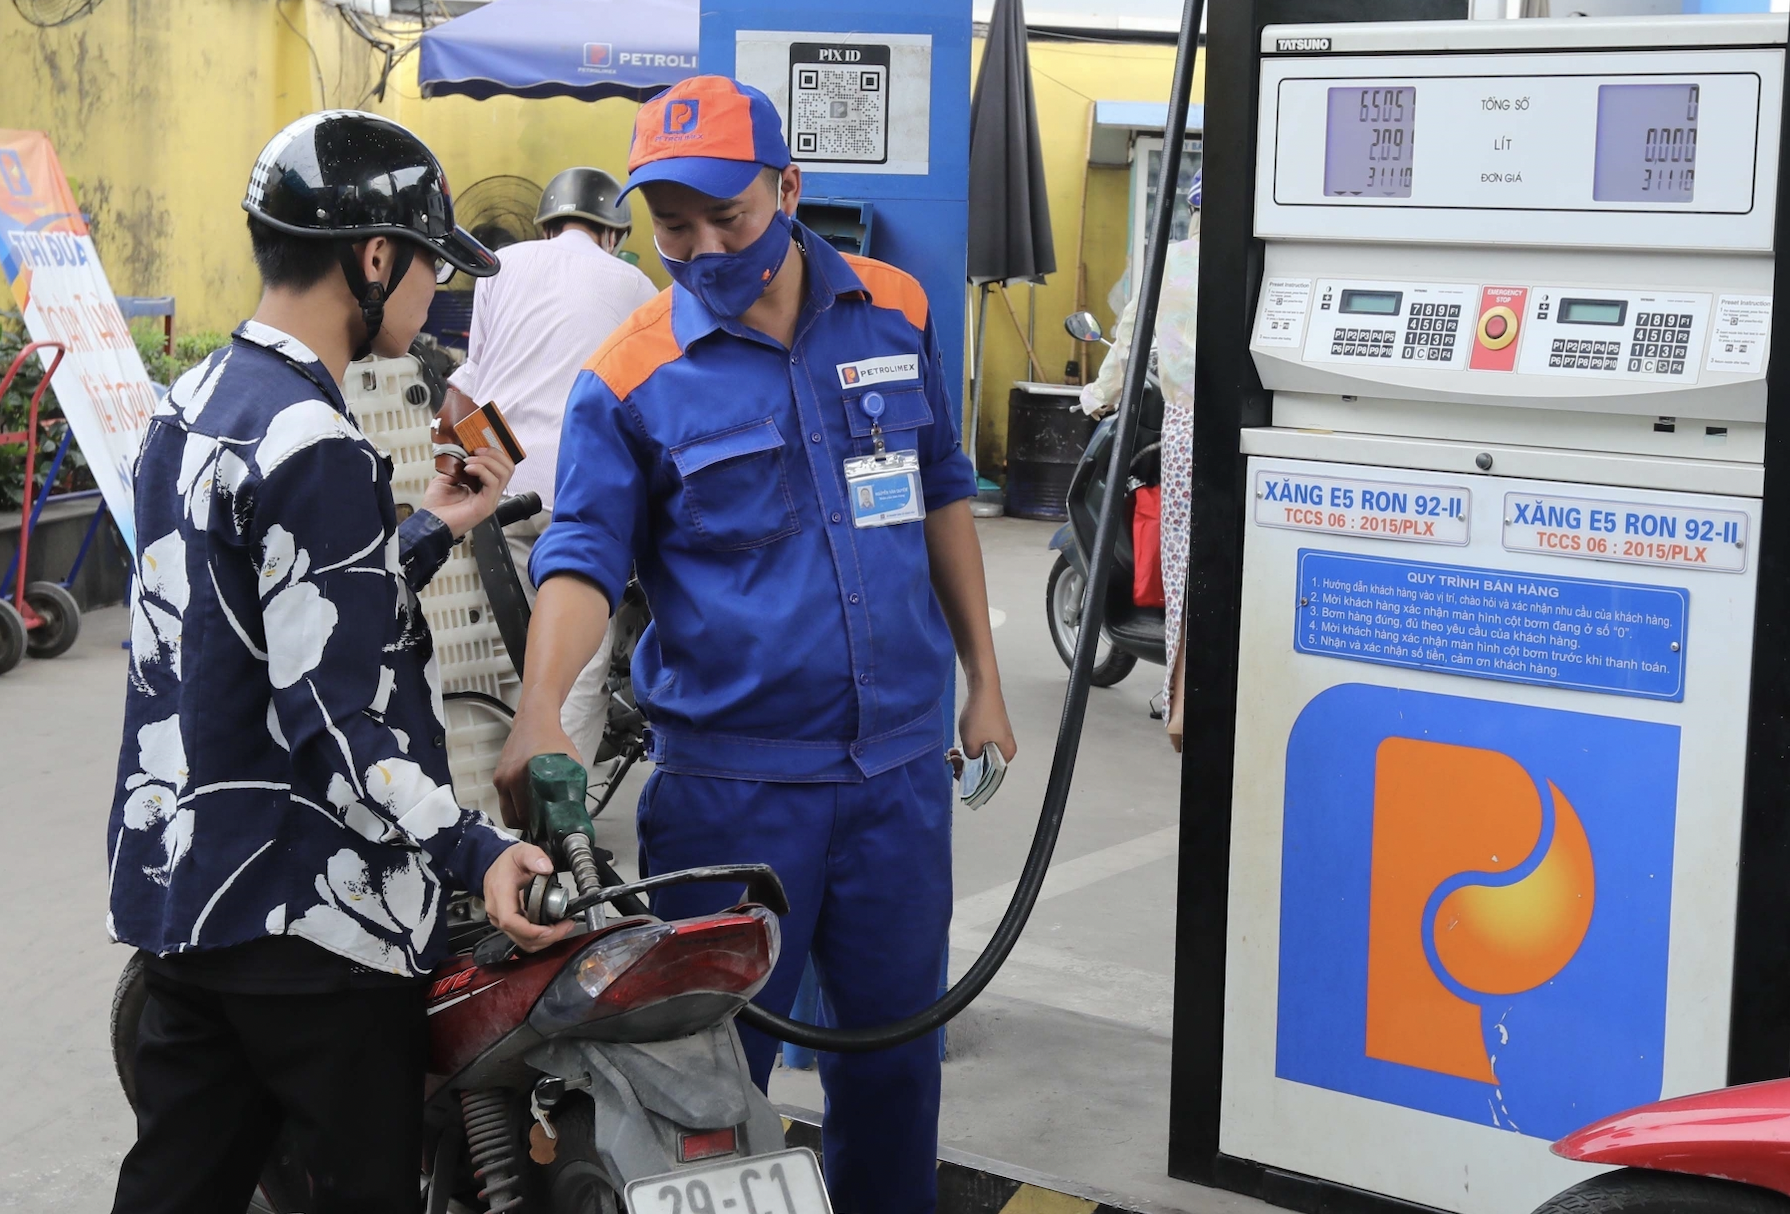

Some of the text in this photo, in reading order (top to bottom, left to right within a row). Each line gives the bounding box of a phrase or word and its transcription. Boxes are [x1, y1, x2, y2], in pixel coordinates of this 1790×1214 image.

[1278, 38, 1329, 50] TATSUNO
[620, 52, 697, 68] PETROLI
[819, 49, 861, 62] PIX ID
[1515, 96, 1530, 111] SỐ
[1686, 86, 1699, 121] 0
[1494, 135, 1512, 150] LÍT
[1367, 167, 1412, 188] 31110
[1505, 171, 1522, 183] GIÁ
[1642, 169, 1694, 190] 31110
[1413, 304, 1445, 315] 7 8 9
[1410, 319, 1442, 330] 4 5 6
[1640, 315, 1675, 326] 7 8 9
[1409, 334, 1440, 345] 1 2 3
[1637, 330, 1672, 341] 4 5 6
[1404, 348, 1425, 358] 0 C
[1635, 345, 1669, 356] 1 2 3
[860, 364, 915, 377] PETROLIMEX
[1631, 360, 1653, 371] 0 C
[1264, 481, 1323, 506] XĂNG
[1330, 486, 1354, 509] E5
[1361, 489, 1407, 513] RON
[1284, 508, 1435, 536] TCCS 06 : 2015/PLX
[1513, 501, 1581, 530] XĂNG
[1589, 509, 1616, 533] E5
[1624, 512, 1677, 538] RON
[1536, 531, 1708, 563] TCCS 06 : 2015/PLX
[1407, 571, 1559, 598] QUY TRÌNH BÁN HÀNG
[1312, 576, 1674, 629] 1. Hướng dẫn khách hàng vào vị trí, chào hỏi và xác nhận nhu cầu của khách hàng.
[1310, 591, 1633, 638] 2. Mời khách hàng xác nhận màn hình cột bơm đang ở số “0”.
[1310, 605, 1582, 650] 3. Bơm hàng đúng, đủ theo yêu cầu của khách hàng.
[1308, 620, 1671, 673] 4. Mời khách hàng xác nhận màn hình cột bơm trước khi thanh toán.
[1308, 633, 1561, 677] 5. Nhận và xác nhận số tiền, cảm ơn khách hàng.
